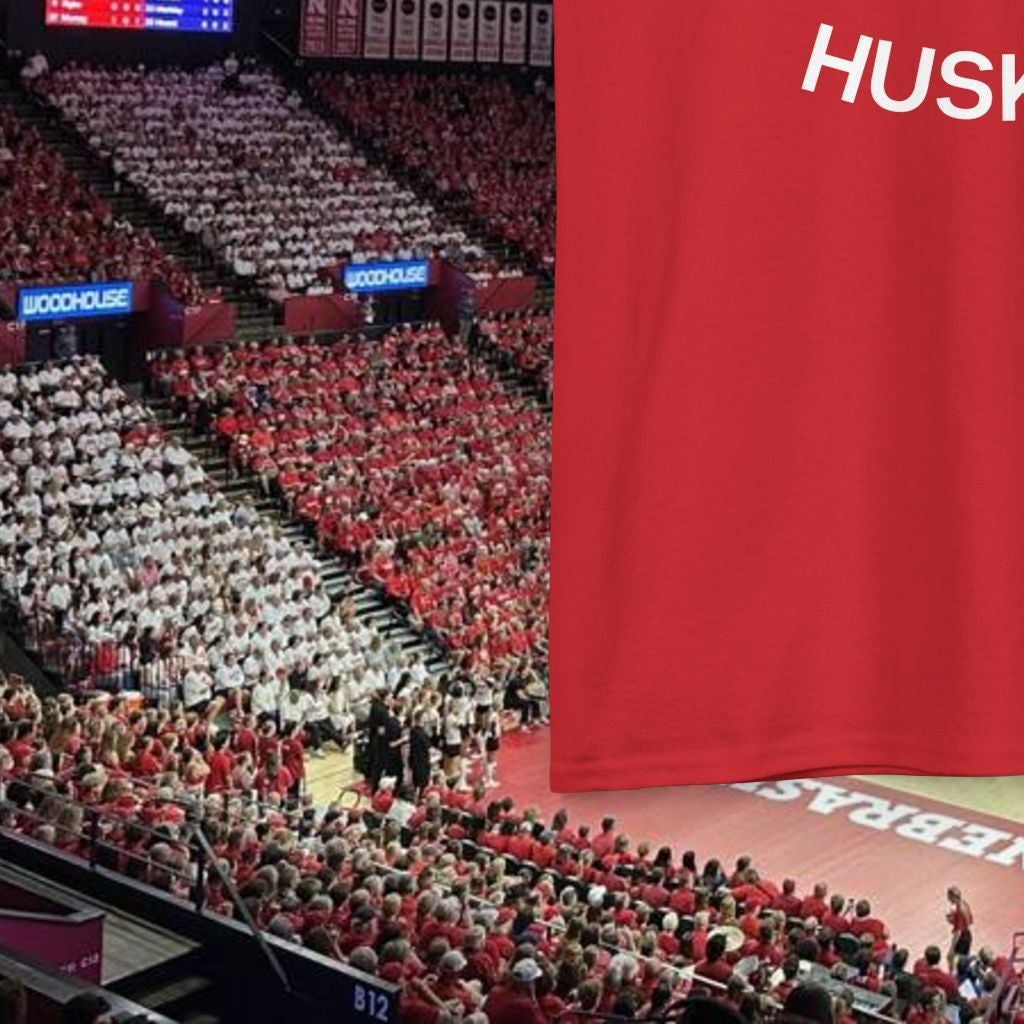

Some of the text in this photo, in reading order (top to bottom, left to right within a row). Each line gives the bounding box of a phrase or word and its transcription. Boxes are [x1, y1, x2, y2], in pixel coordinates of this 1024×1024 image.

[344, 265, 427, 288] WOODHOUSE
[22, 288, 129, 315] WOODHOUSE
[355, 985, 388, 1022] B12
